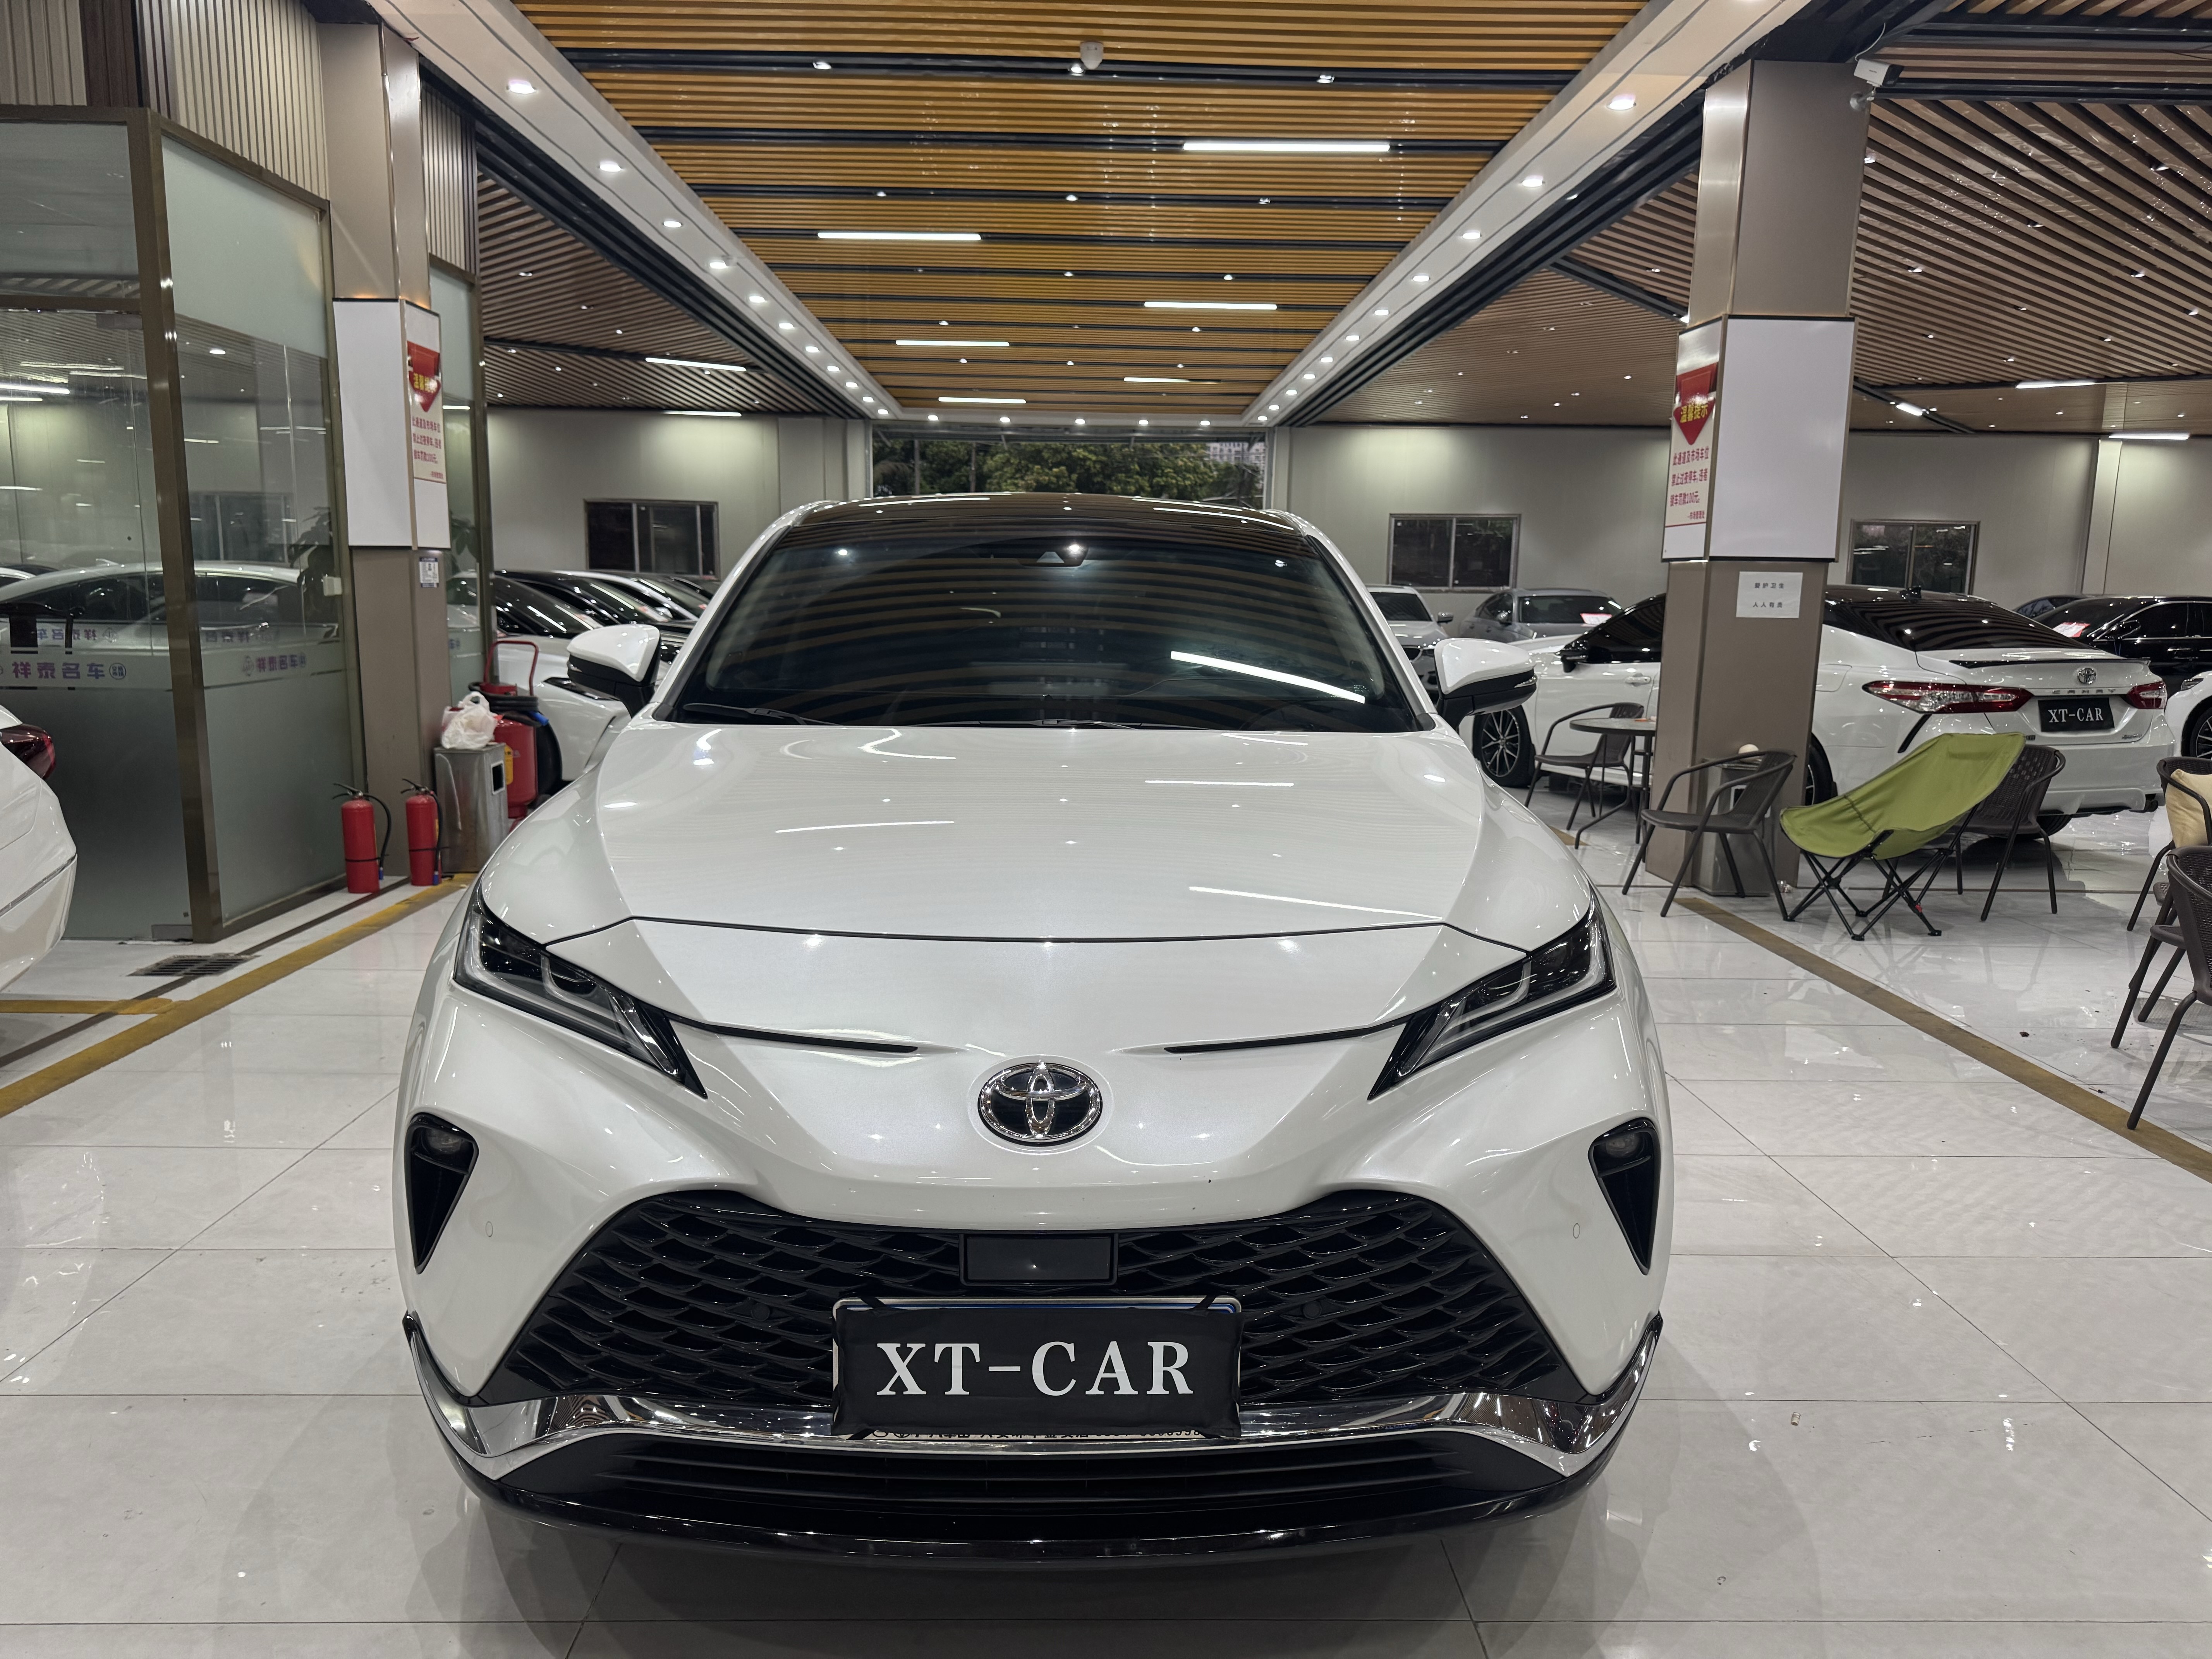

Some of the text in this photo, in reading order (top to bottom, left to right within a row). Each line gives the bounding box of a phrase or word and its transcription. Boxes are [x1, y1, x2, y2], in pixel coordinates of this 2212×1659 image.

[12, 661, 105, 679] 祥泰名车
[2048, 708, 2104, 723] XT-CAR
[876, 1341, 1193, 1396] XT-CAR
